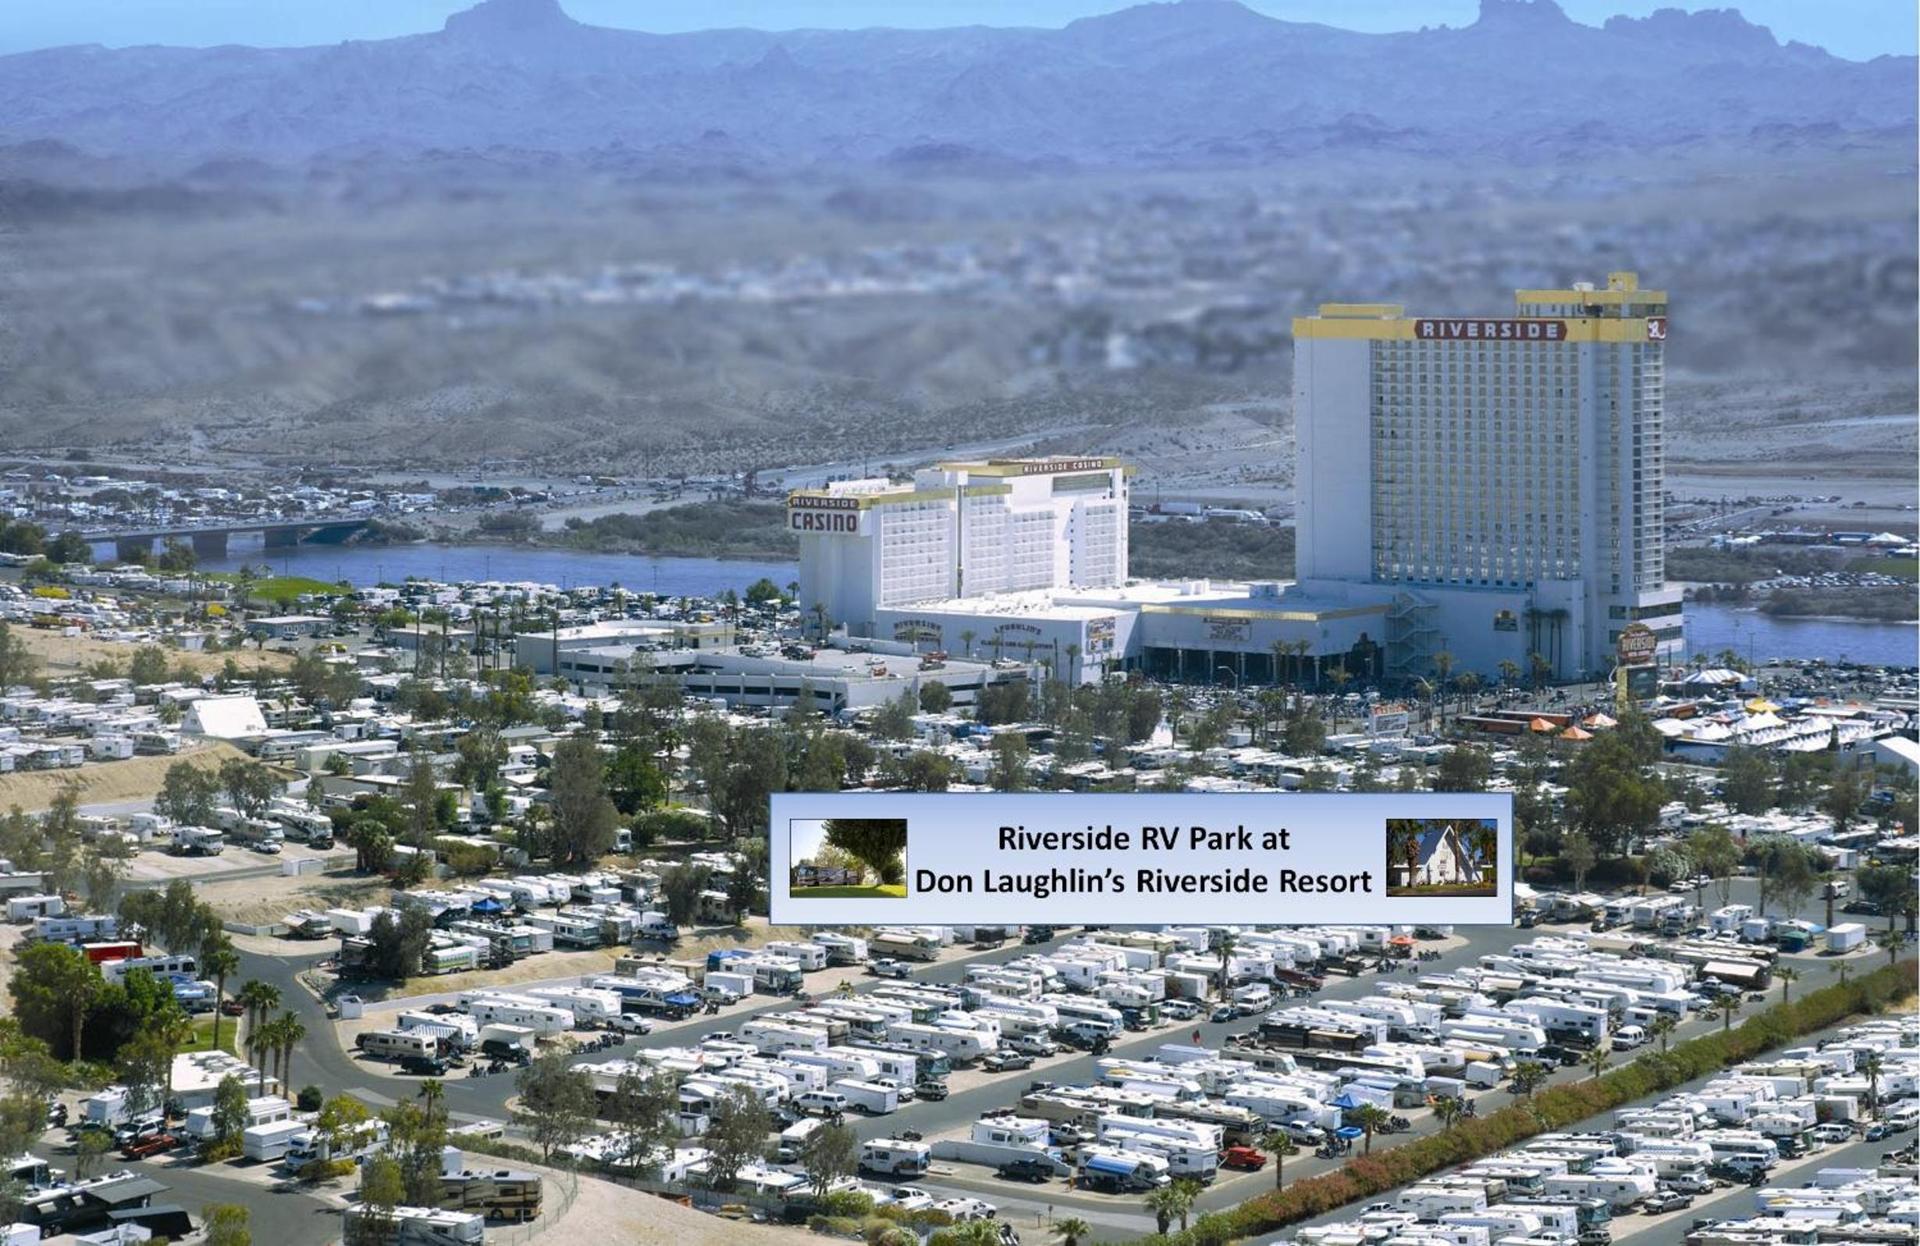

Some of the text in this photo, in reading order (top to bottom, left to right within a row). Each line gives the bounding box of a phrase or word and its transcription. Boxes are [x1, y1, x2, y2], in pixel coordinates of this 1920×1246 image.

[1422, 321, 1559, 338] RIVERSIDE
[1024, 460, 1102, 473] RIVERSIDE CASINO
[792, 498, 857, 508] RIVERSIDE
[792, 512, 857, 532] CASINO
[1622, 635, 1656, 652] RIVERSIDE
